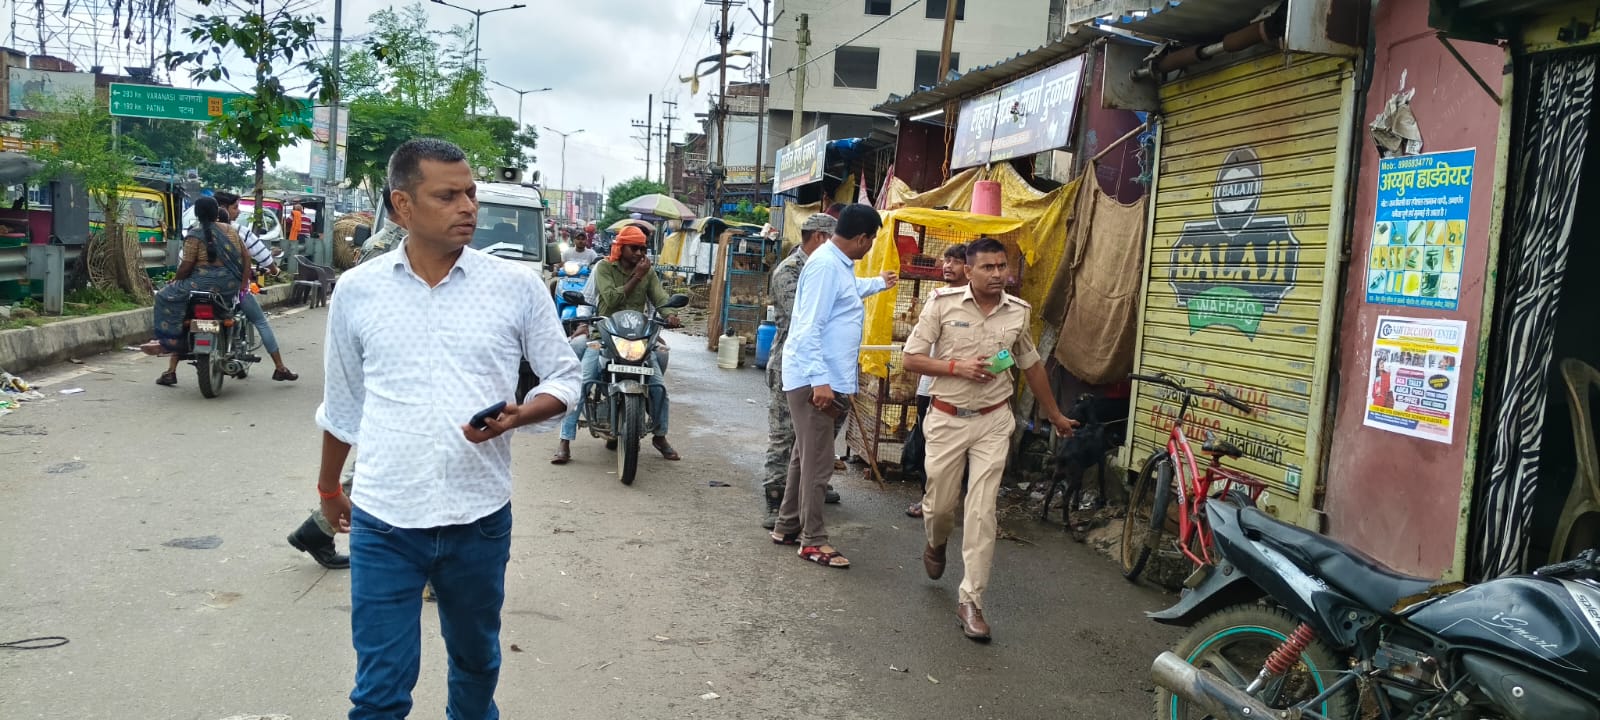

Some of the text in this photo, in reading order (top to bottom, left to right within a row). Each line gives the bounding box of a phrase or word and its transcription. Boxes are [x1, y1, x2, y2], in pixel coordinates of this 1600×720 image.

[146, 92, 176, 101] VARANASI
[1040, 70, 1078, 122] दुकान
[146, 104, 165, 113] PATNA
[1222, 184, 1254, 197] BALAJI
[1175, 240, 1291, 282] BALAJI
[1195, 297, 1256, 325] WAFERS
[1434, 328, 1458, 340] CENTER
